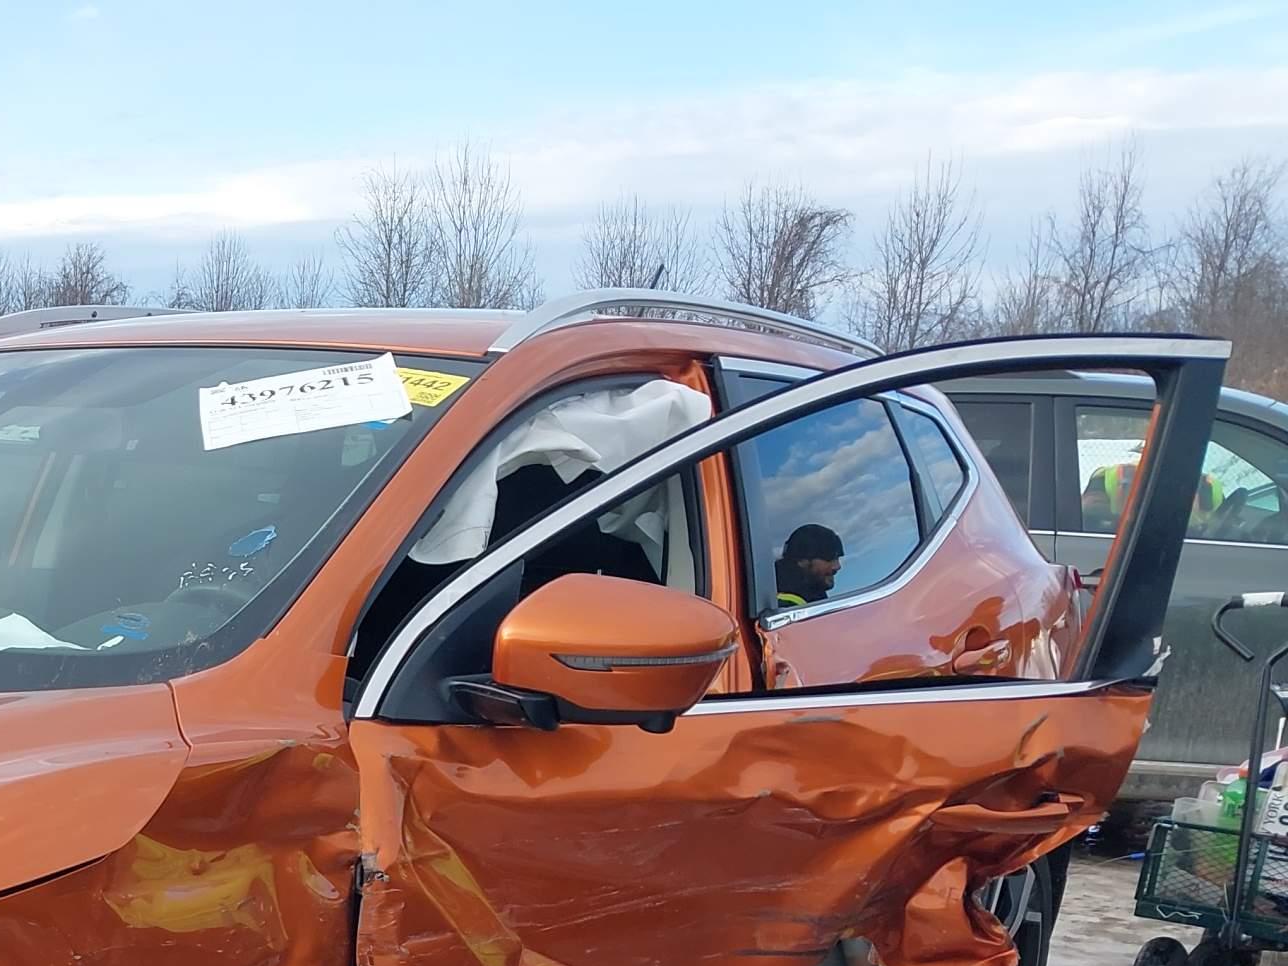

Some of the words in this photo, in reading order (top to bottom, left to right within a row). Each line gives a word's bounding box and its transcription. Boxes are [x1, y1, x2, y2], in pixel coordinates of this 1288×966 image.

[220, 373, 375, 406] 43976215
[399, 374, 451, 391] 1442
[1263, 793, 1285, 825] YORK
